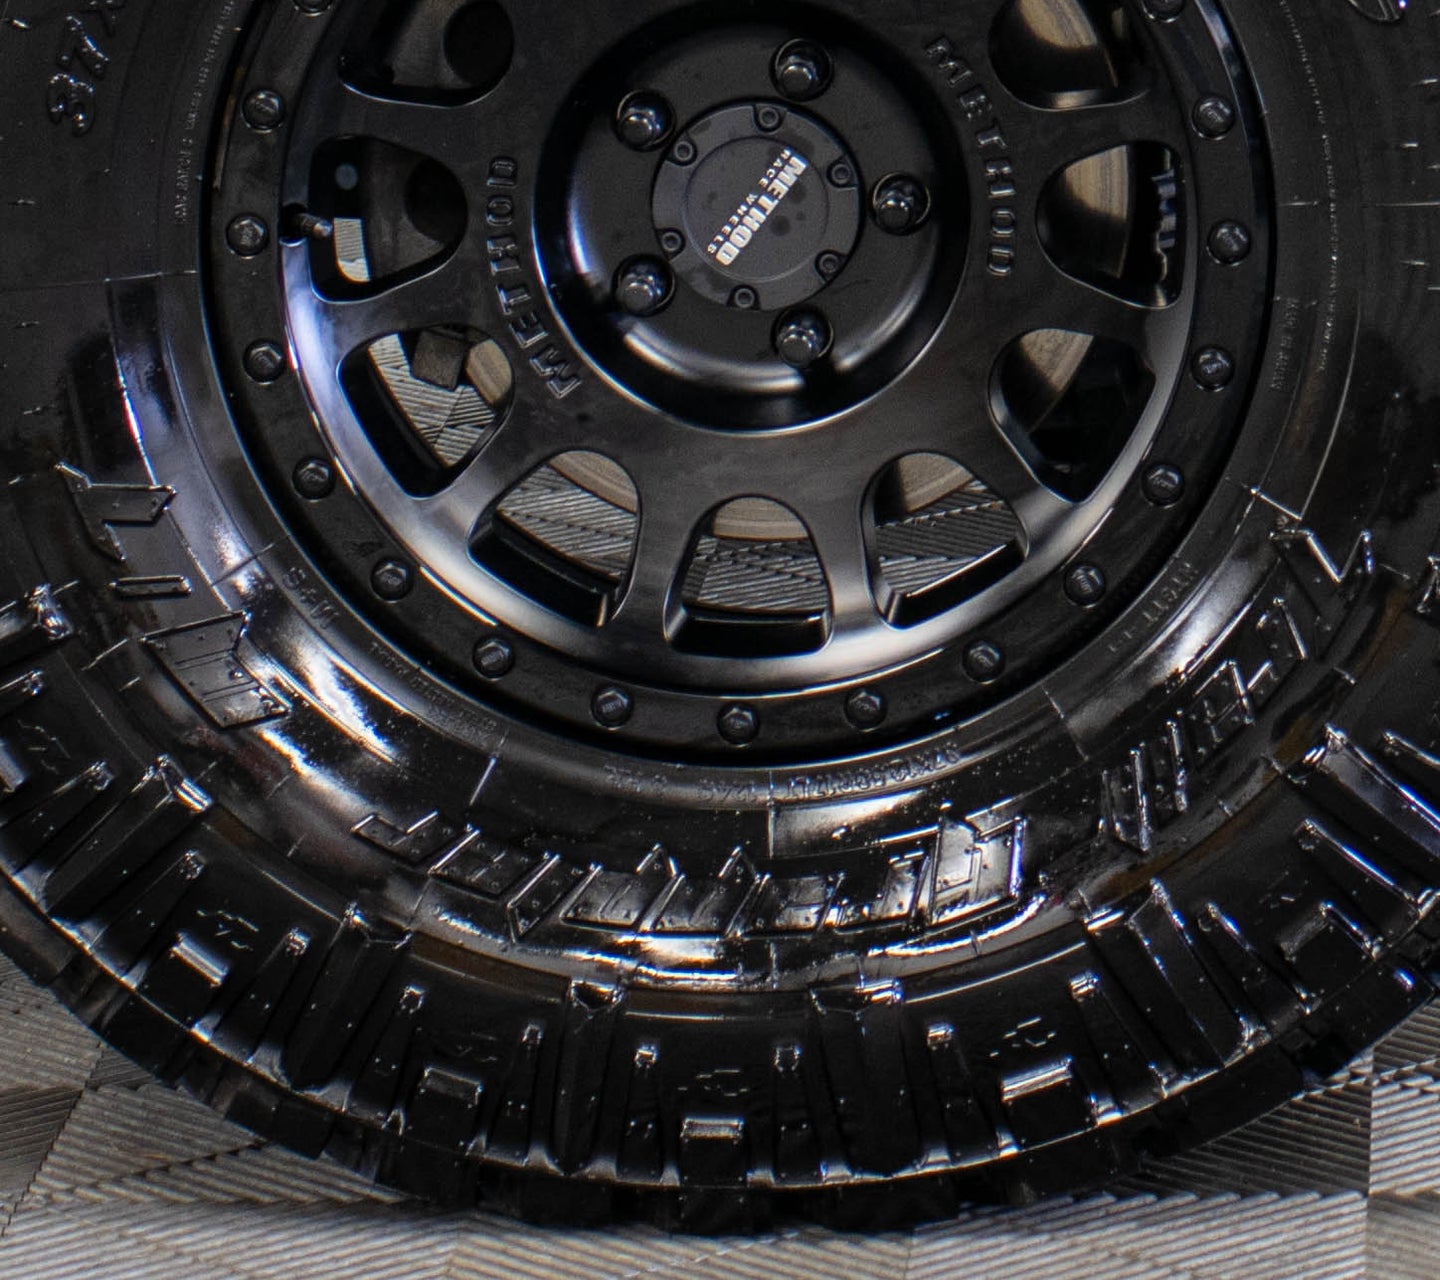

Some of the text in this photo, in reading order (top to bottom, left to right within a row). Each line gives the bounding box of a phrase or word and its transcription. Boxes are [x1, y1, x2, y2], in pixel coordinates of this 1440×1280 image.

[705, 147, 792, 255] RACE WHEELS
[714, 153, 809, 266] METHOD
[924, 37, 1017, 276] METHOD
[485, 155, 581, 399] METHOD
